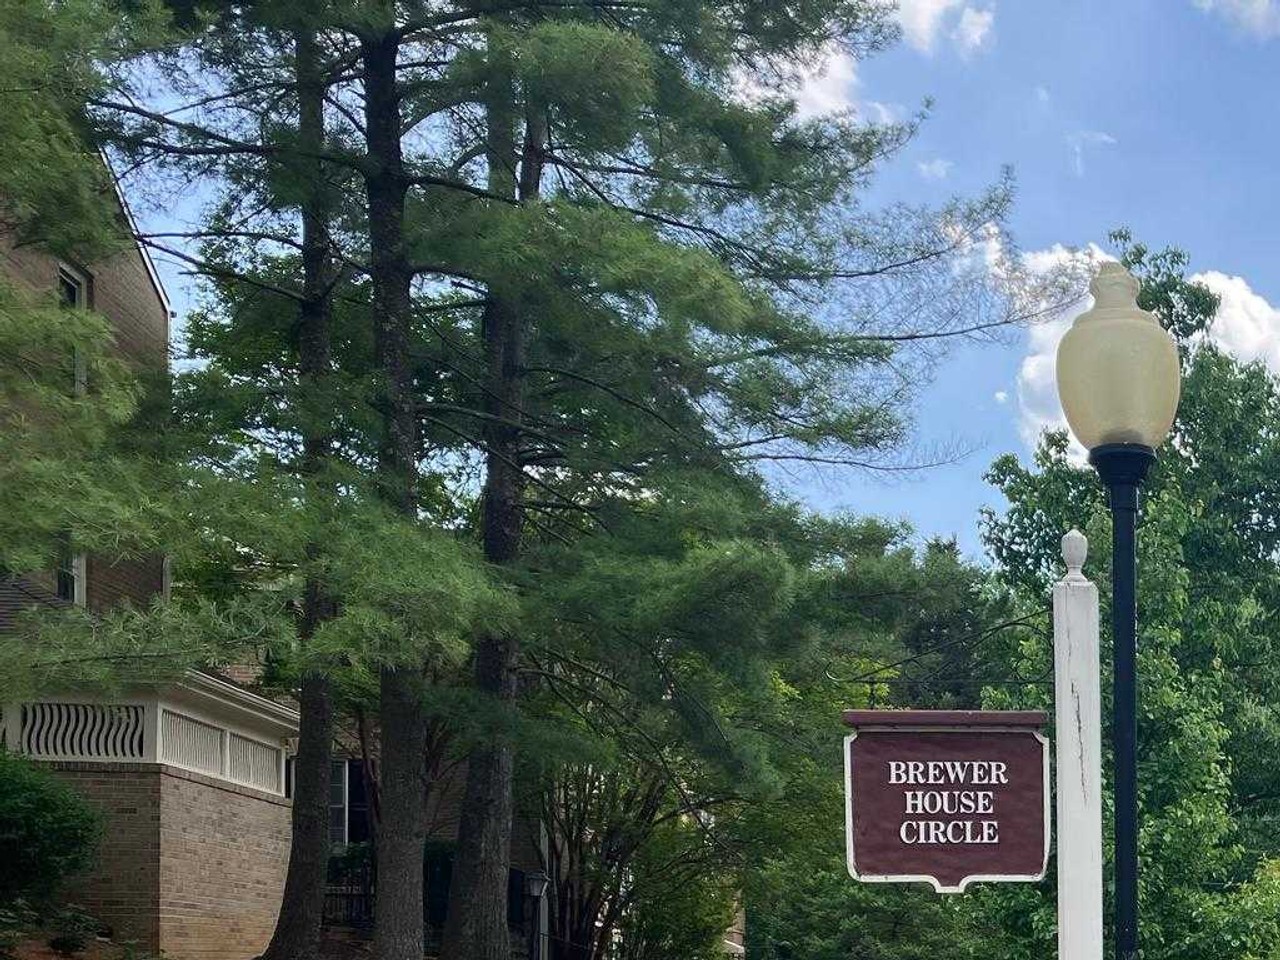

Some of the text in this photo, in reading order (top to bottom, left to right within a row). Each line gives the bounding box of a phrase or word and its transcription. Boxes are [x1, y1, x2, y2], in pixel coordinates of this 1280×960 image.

[888, 761, 1008, 784] BREWER
[904, 791, 994, 814] HOUSE
[899, 821, 998, 844] CIRCLE
